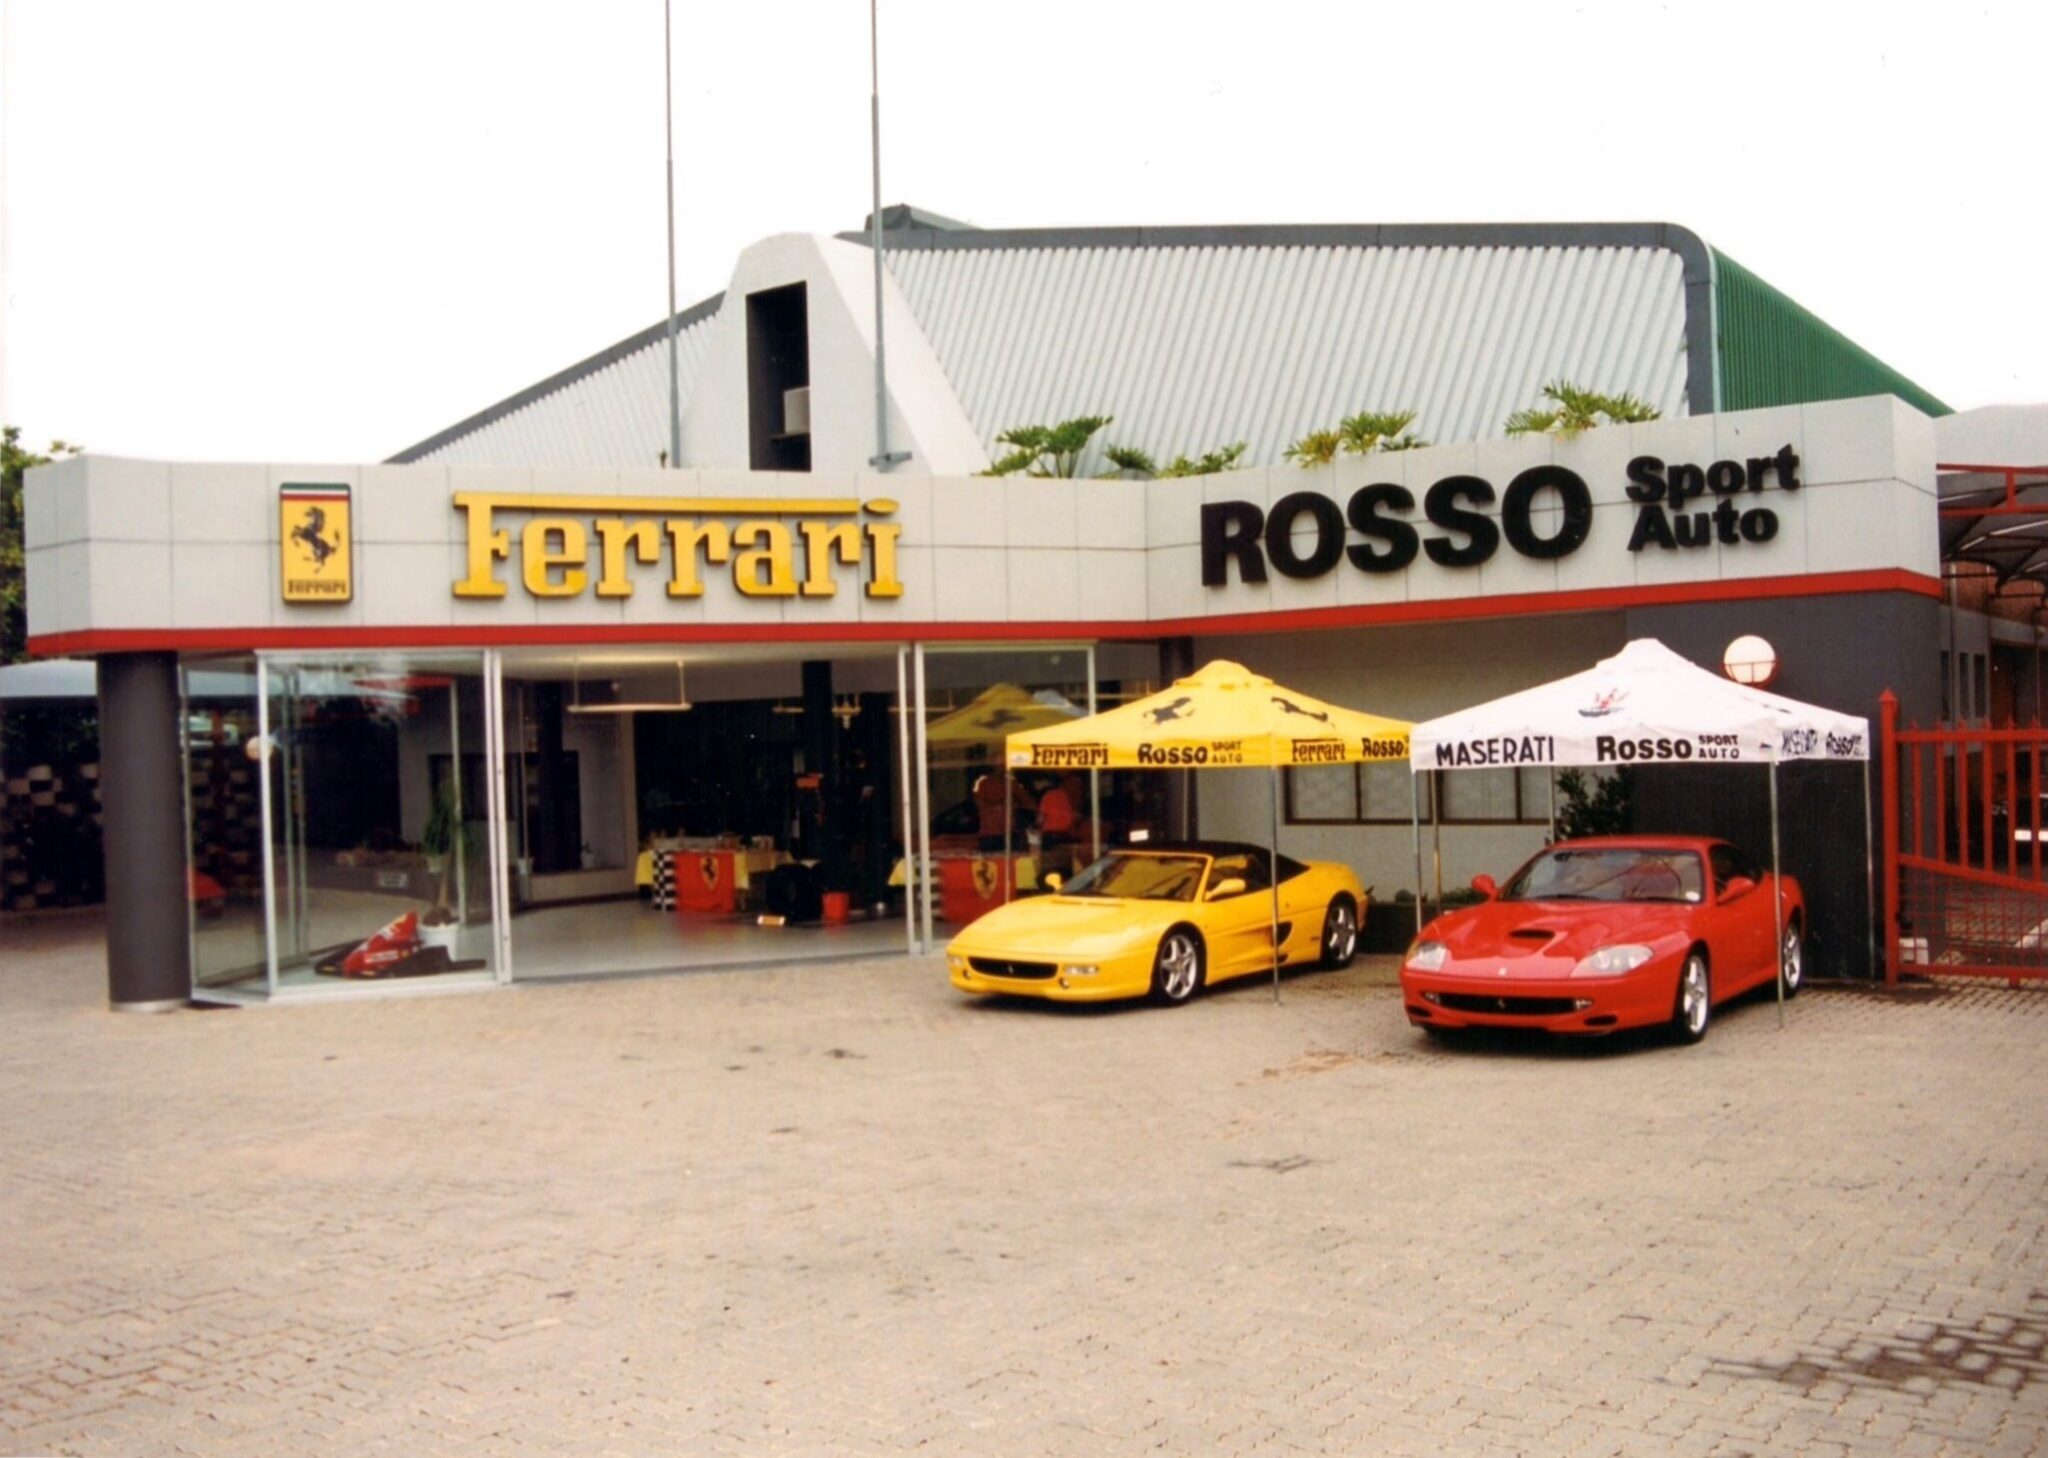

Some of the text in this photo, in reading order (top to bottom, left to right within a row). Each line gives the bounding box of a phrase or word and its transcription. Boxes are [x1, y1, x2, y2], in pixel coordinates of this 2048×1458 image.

[1624, 443, 1800, 508] Sport
[1200, 464, 1594, 587] ROSSO
[1626, 498, 1780, 553] Auto
[452, 491, 904, 598] Ferrari
[287, 579, 346, 594] Ferrari
[1211, 740, 1242, 752] SPORT
[1291, 738, 1346, 763] Ferrari
[1435, 735, 1555, 767] MASERATI
[1698, 734, 1740, 746] SPORT
[1031, 743, 1109, 766] Ferrari
[1211, 752, 1243, 764] AUTO
[1698, 748, 1740, 760] AUTO
